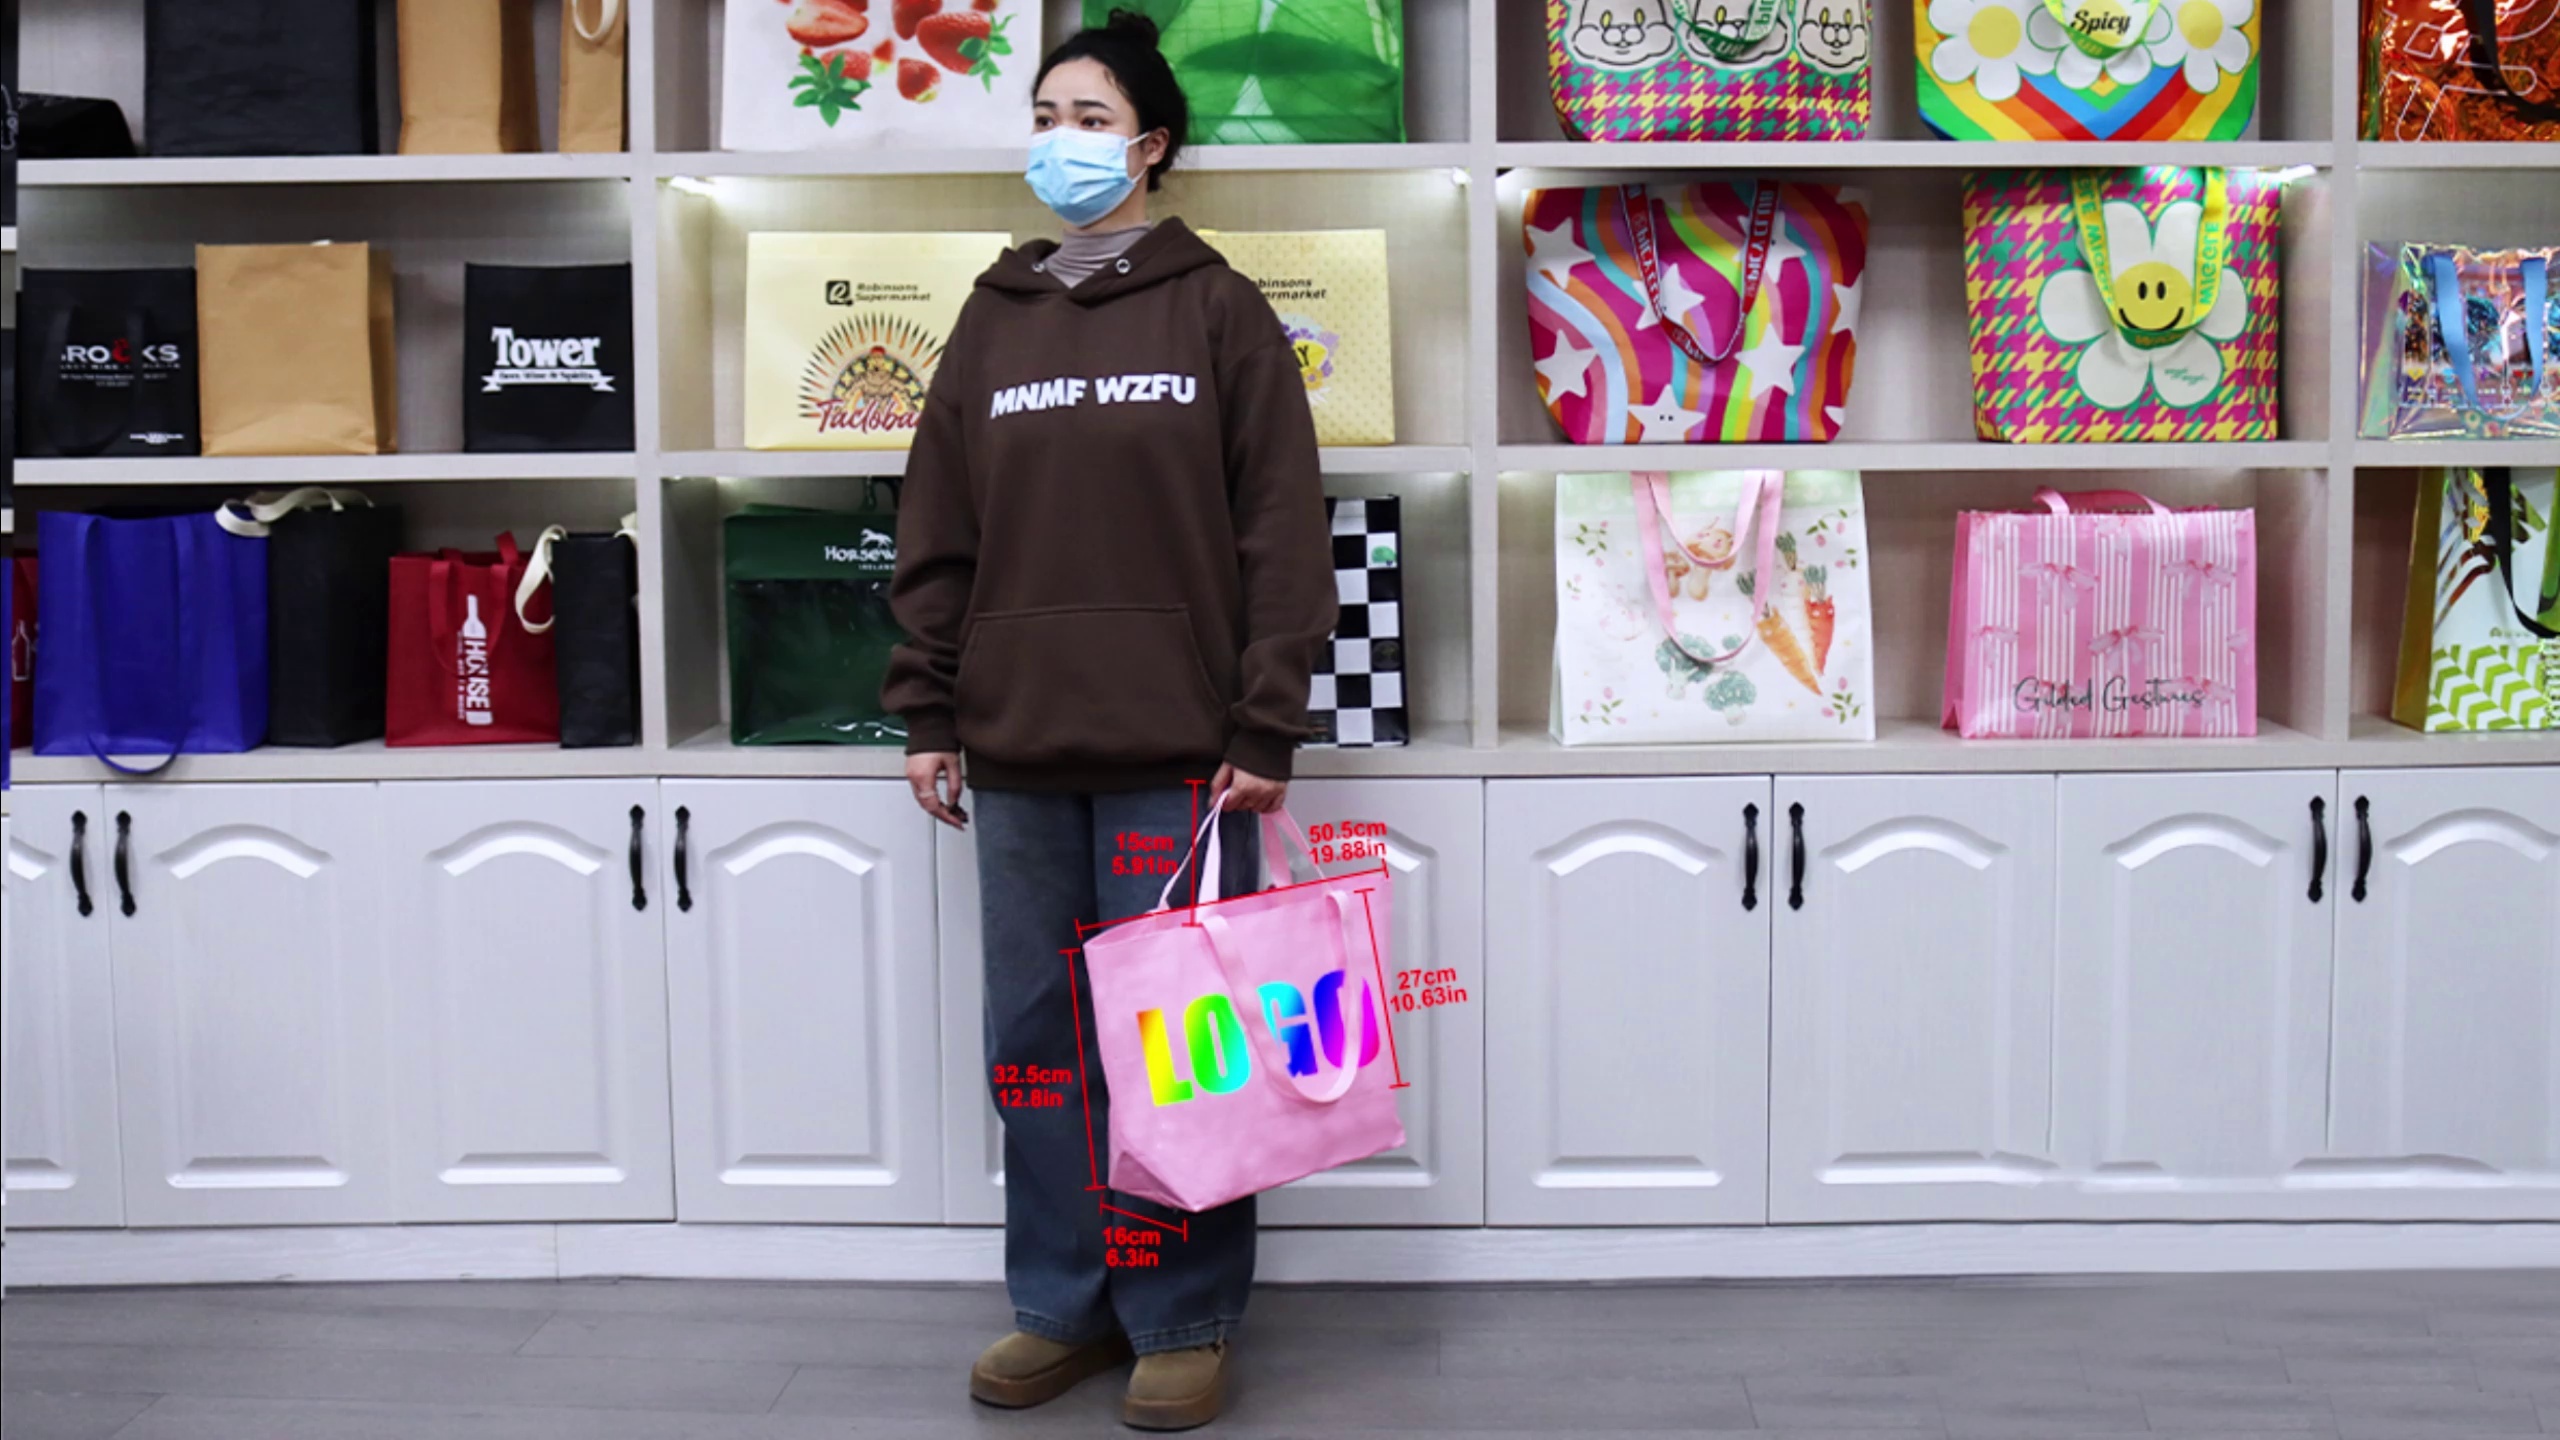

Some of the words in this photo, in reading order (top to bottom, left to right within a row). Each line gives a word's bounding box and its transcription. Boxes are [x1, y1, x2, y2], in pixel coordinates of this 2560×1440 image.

[2070, 9, 2131, 35] Spicy
[854, 292, 931, 302] Supermarket
[856, 282, 918, 291] Robinsons
[1258, 278, 1312, 289] binsons
[1265, 289, 1327, 300] ermarket
[491, 326, 601, 368] Tower
[990, 377, 1087, 419] MNMF
[1095, 373, 1196, 404] WZFU
[816, 399, 921, 433] Tacloba
[2014, 676, 2092, 712] Gilded
[2103, 676, 2207, 712] Gestures
[1136, 968, 1381, 1108] LOGO
